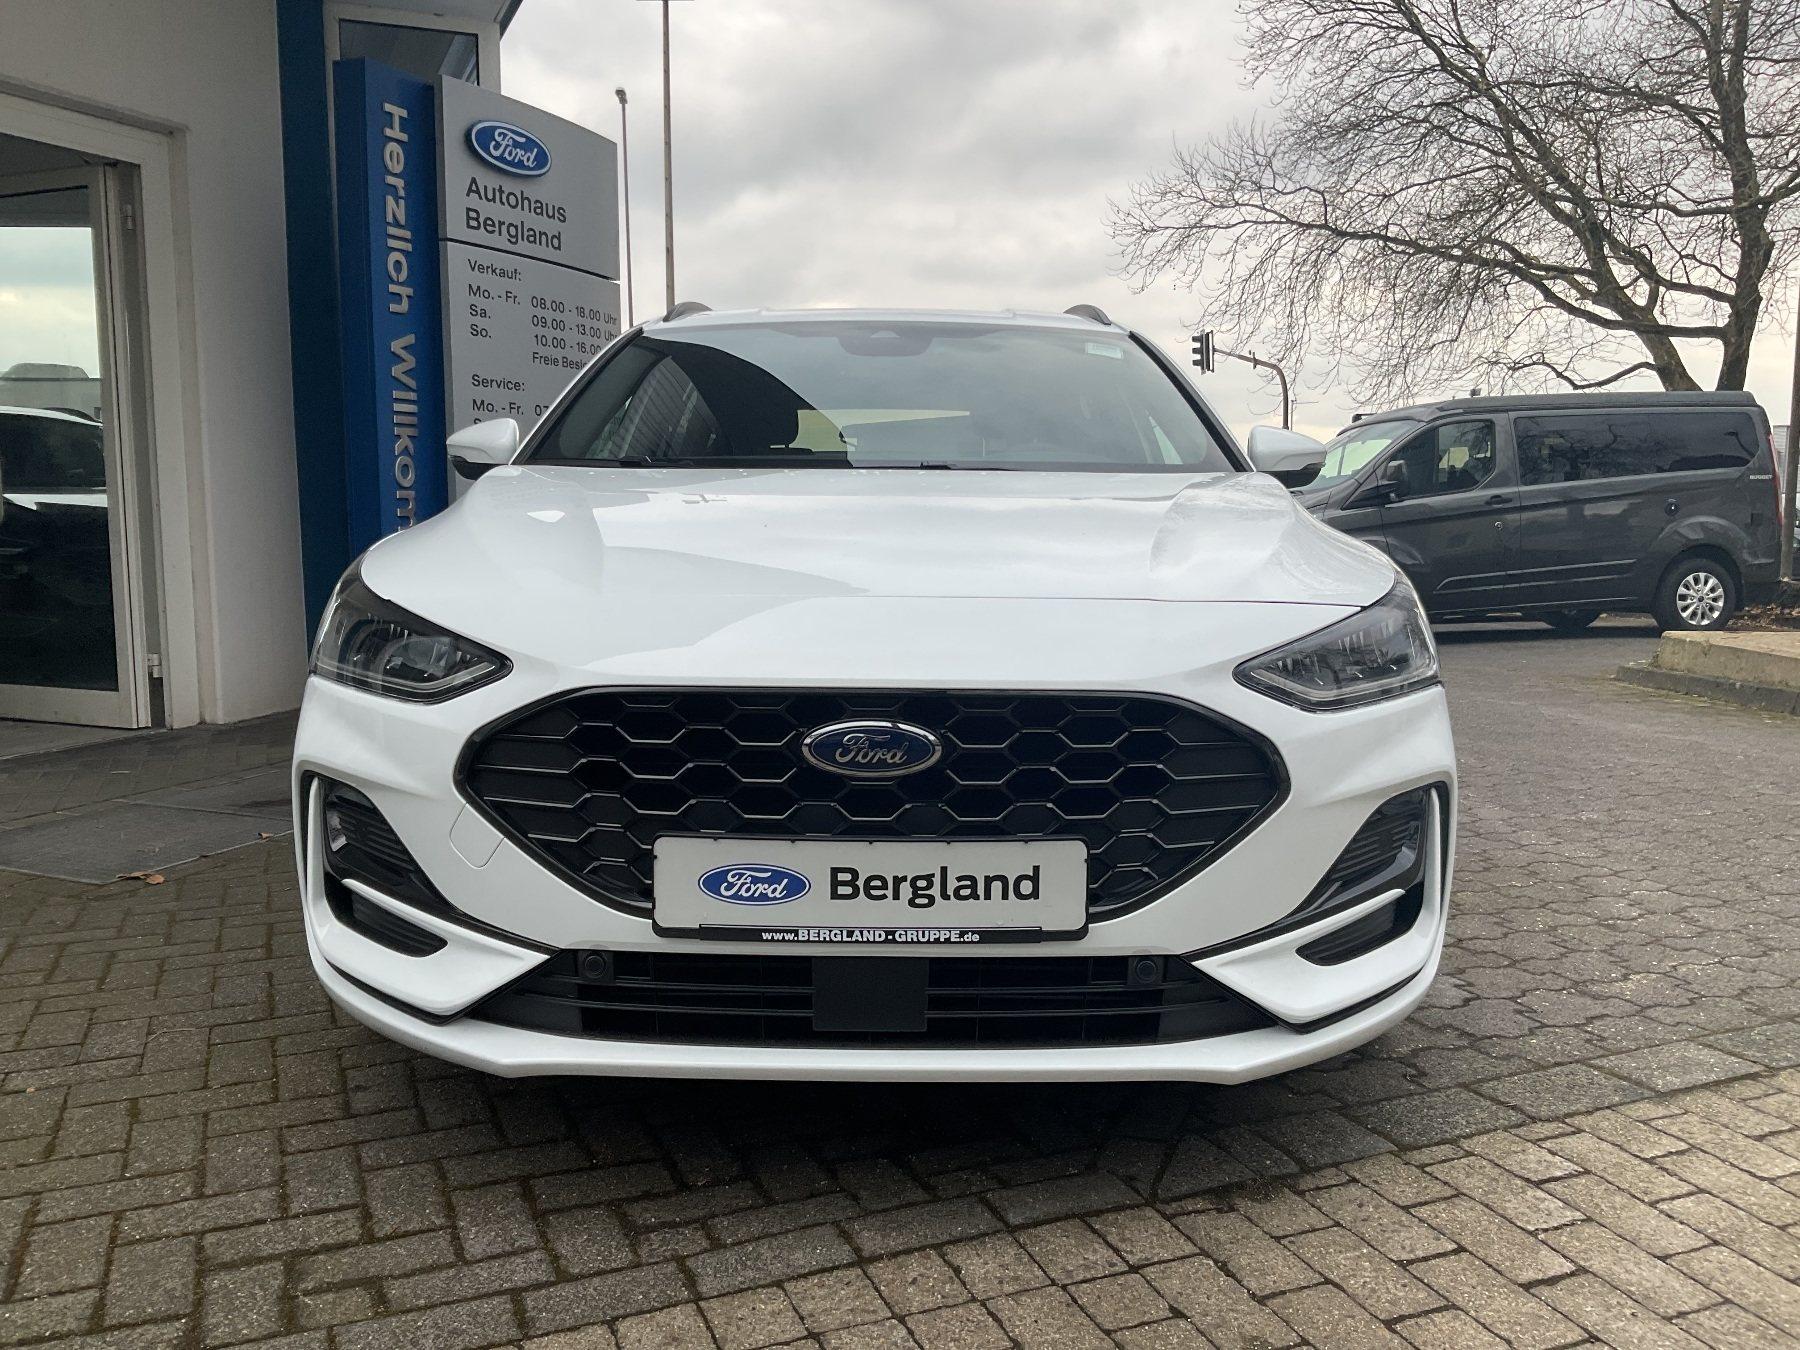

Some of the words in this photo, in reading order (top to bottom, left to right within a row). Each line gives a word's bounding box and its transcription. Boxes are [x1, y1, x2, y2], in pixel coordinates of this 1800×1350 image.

[489, 126, 537, 168] Ford
[383, 102, 413, 313] Herzlich
[465, 176, 567, 223] Autohaus
[465, 207, 562, 251] Bergland
[468, 258, 522, 281] Verkauf:
[468, 283, 495, 300] Mo.
[505, 291, 521, 305] Fr.
[531, 296, 565, 313] 08.00
[575, 306, 600, 322] 18.00
[604, 313, 617, 326] Uhr
[469, 303, 491, 319] Sa.
[532, 314, 566, 332] 09.00
[576, 324, 601, 339] 13.00
[470, 323, 492, 339] So.
[534, 334, 566, 350] 10.00
[532, 352, 560, 367] Freie
[471, 374, 526, 392] Service:
[472, 398, 498, 413] Mo.
[509, 402, 524, 416] Fr.
[835, 733, 908, 765] Ford
[720, 870, 788, 899] Ford
[829, 865, 1042, 908] Bergland
